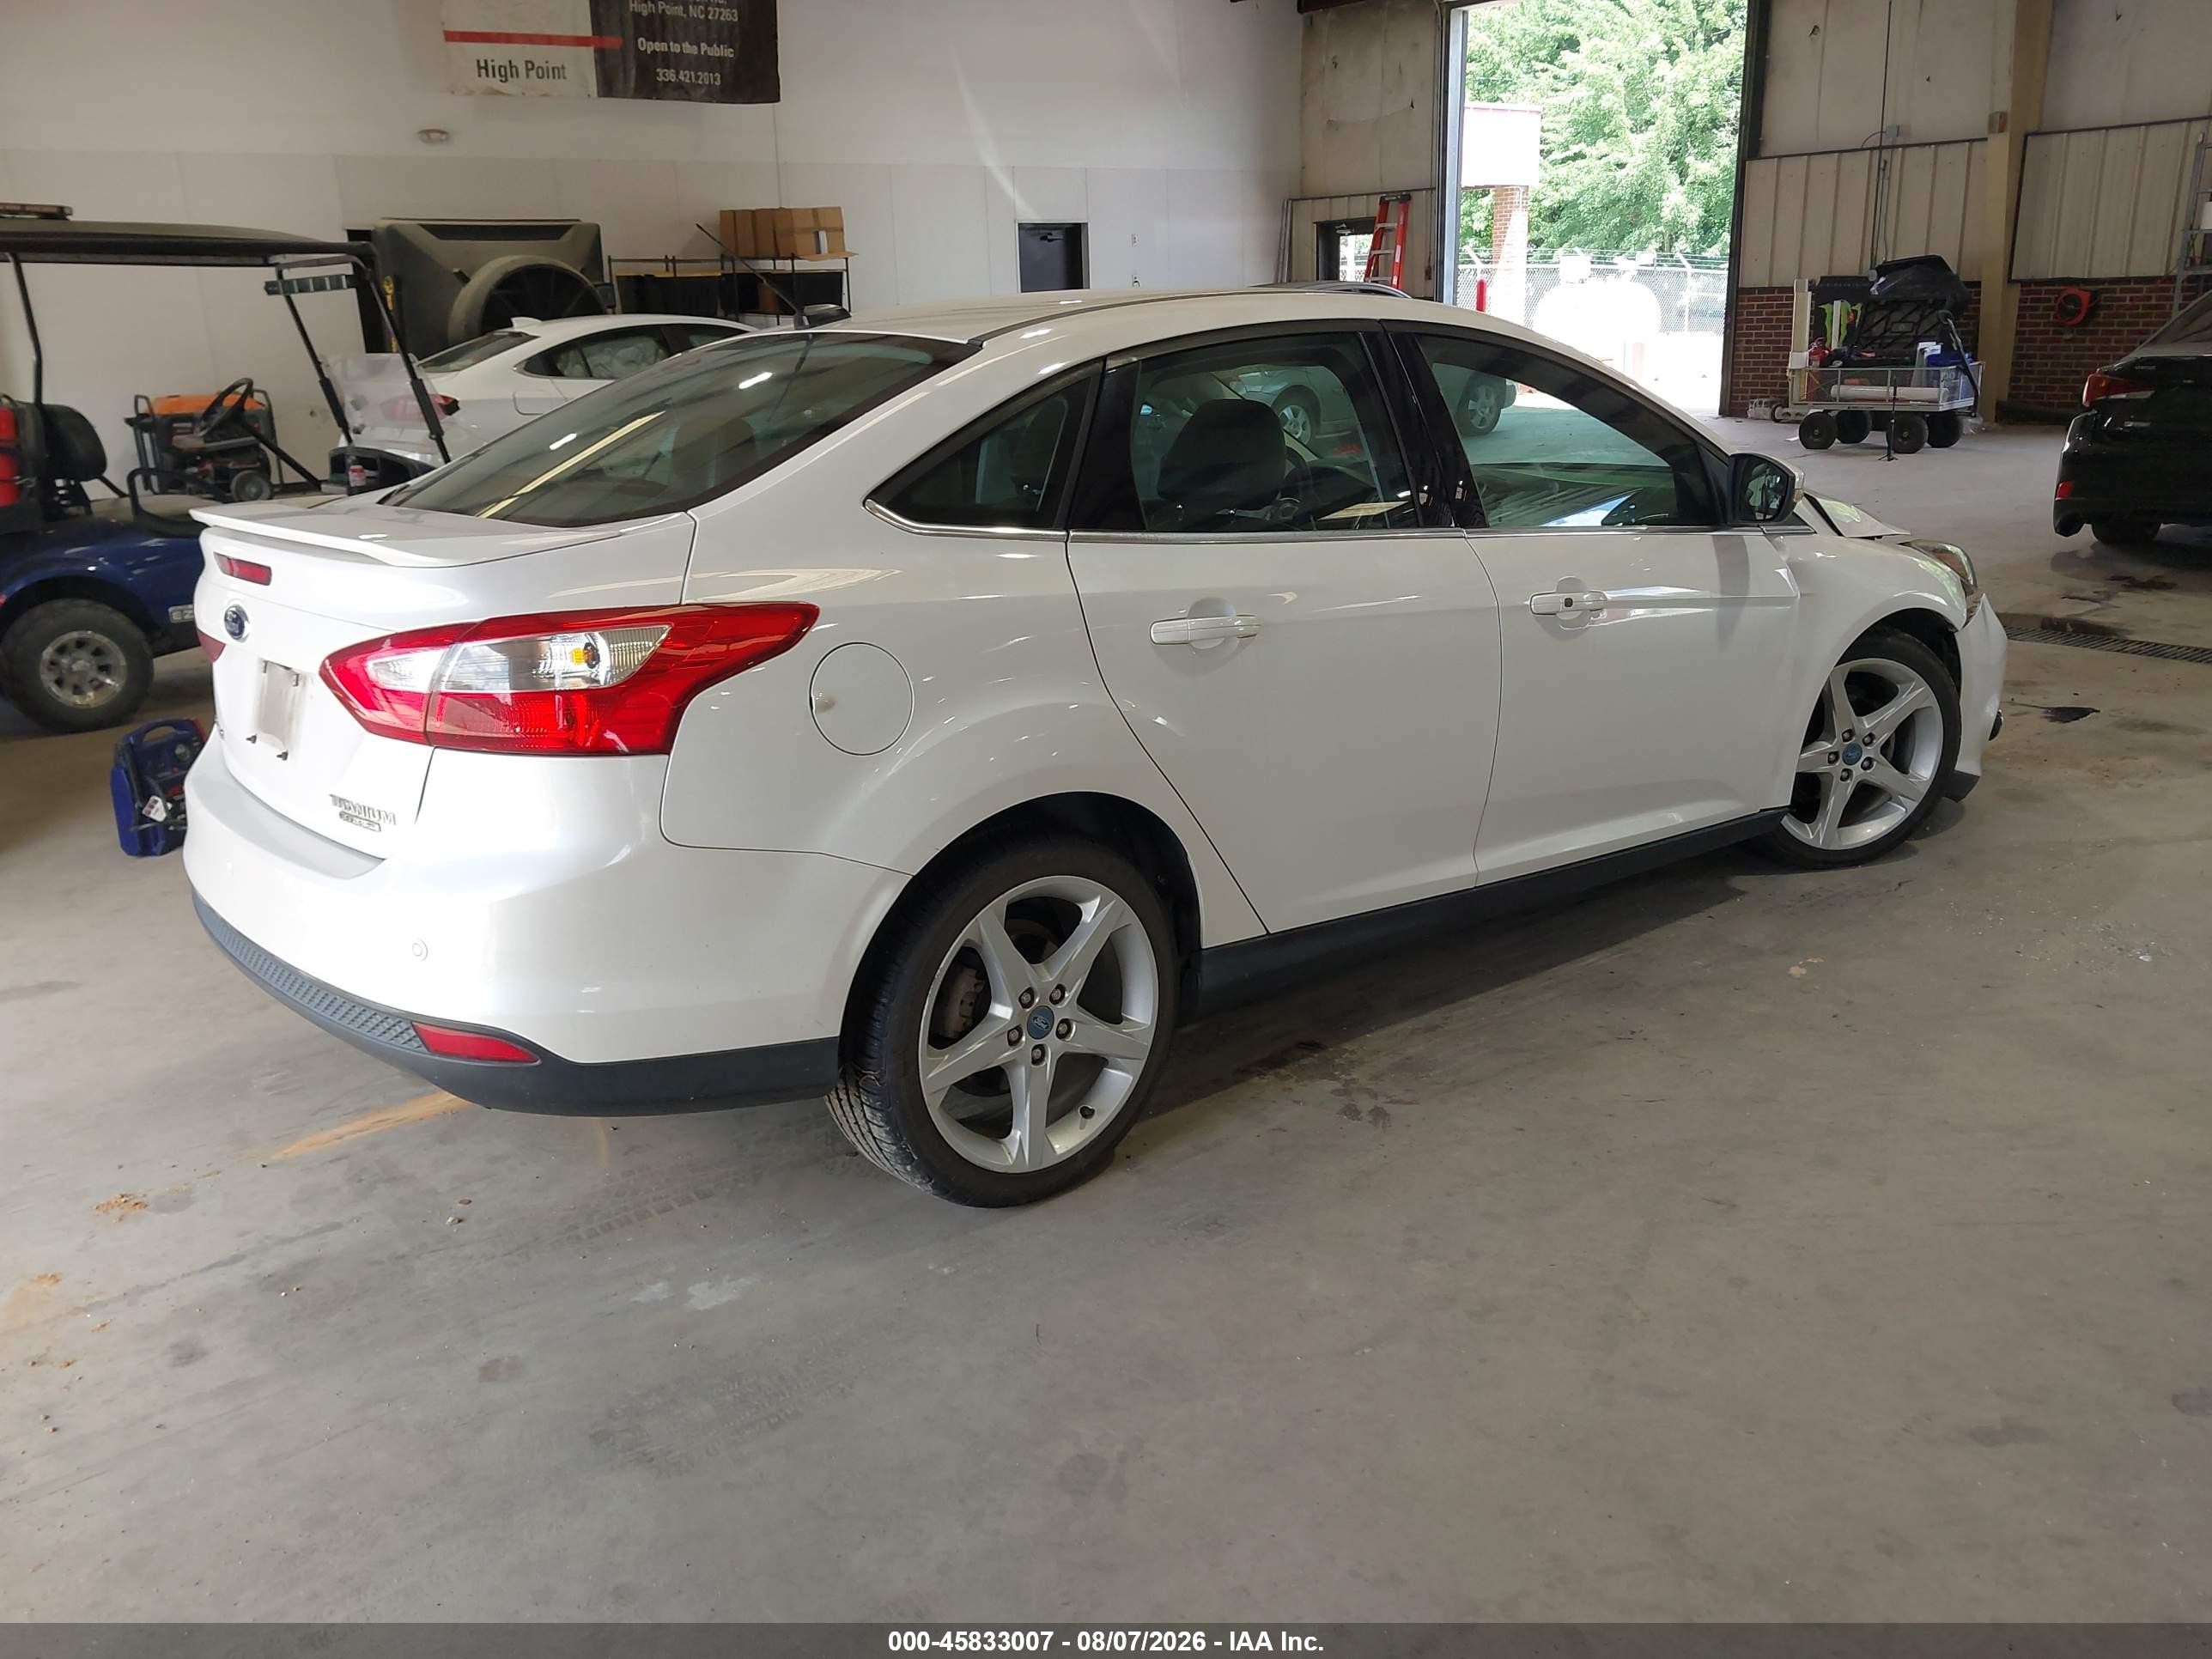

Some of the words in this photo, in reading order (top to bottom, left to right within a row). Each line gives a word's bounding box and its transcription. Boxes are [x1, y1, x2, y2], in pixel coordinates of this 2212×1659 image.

[629, 0, 655, 16] High
[688, 5, 705, 19] NC
[707, 7, 738, 21] 27263
[637, 37, 668, 54] Open
[670, 41, 681, 53] to
[682, 41, 698, 54] the
[700, 42, 735, 58] Public
[476, 59, 520, 82] High
[525, 60, 567, 79] Point
[656, 69, 721, 85] 336.421.2013
[329, 793, 397, 826] TITANIUM
